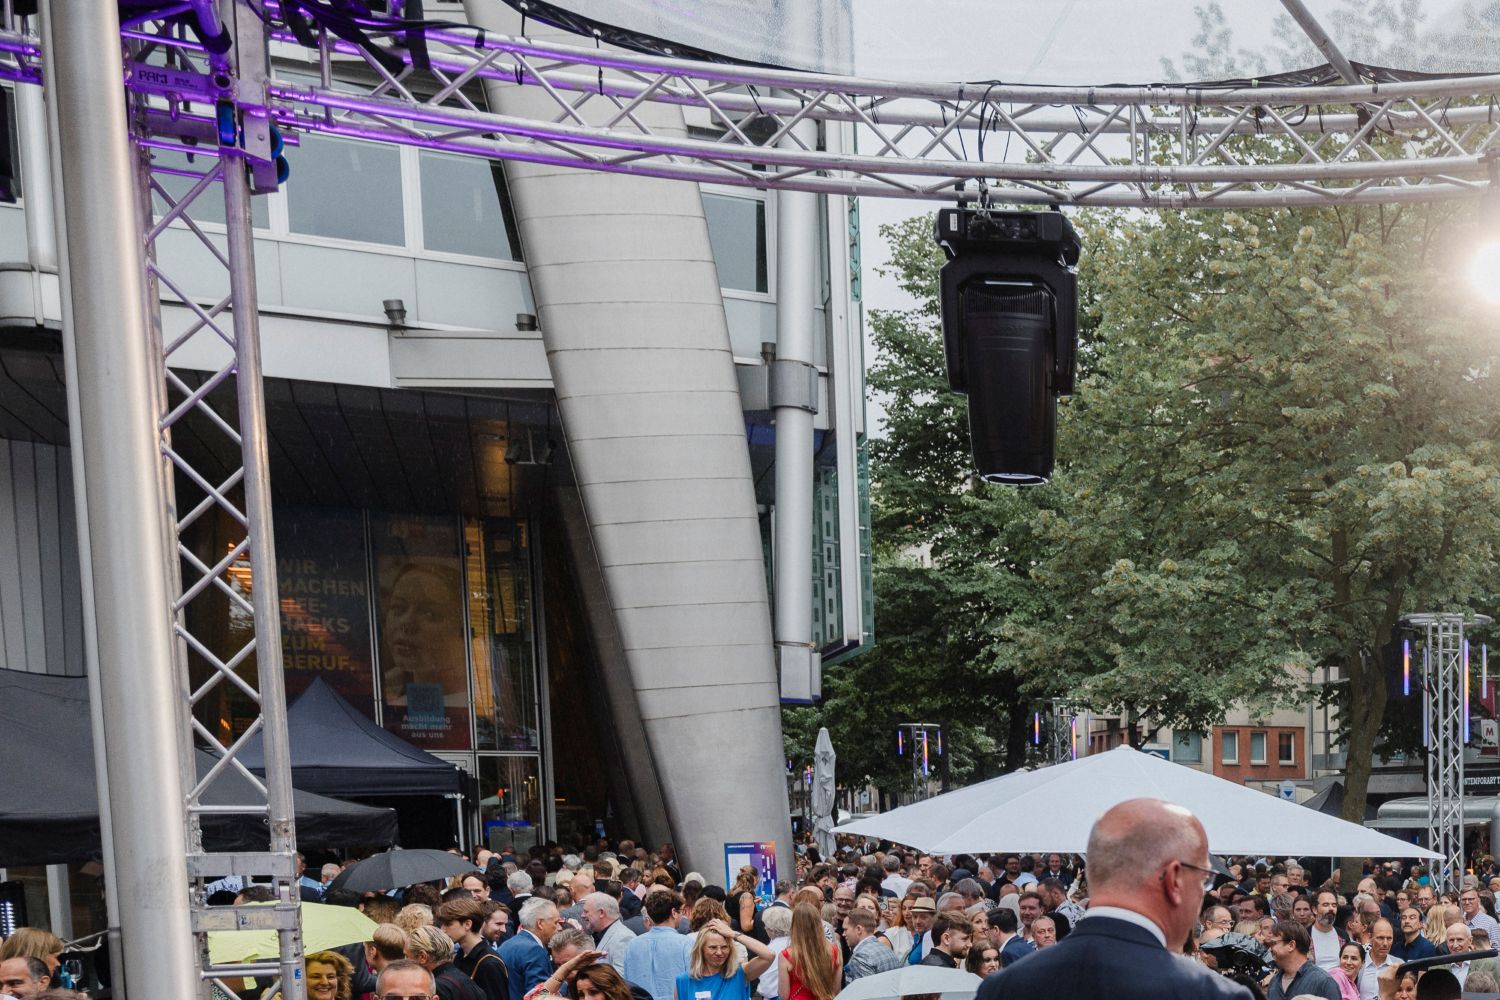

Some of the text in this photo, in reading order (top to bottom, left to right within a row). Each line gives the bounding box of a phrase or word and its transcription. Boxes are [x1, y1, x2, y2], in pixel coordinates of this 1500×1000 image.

[402, 714, 451, 724] Ausbildung
[1485, 728, 1494, 737] M
[1463, 776, 1497, 786] NTEMPORARY
